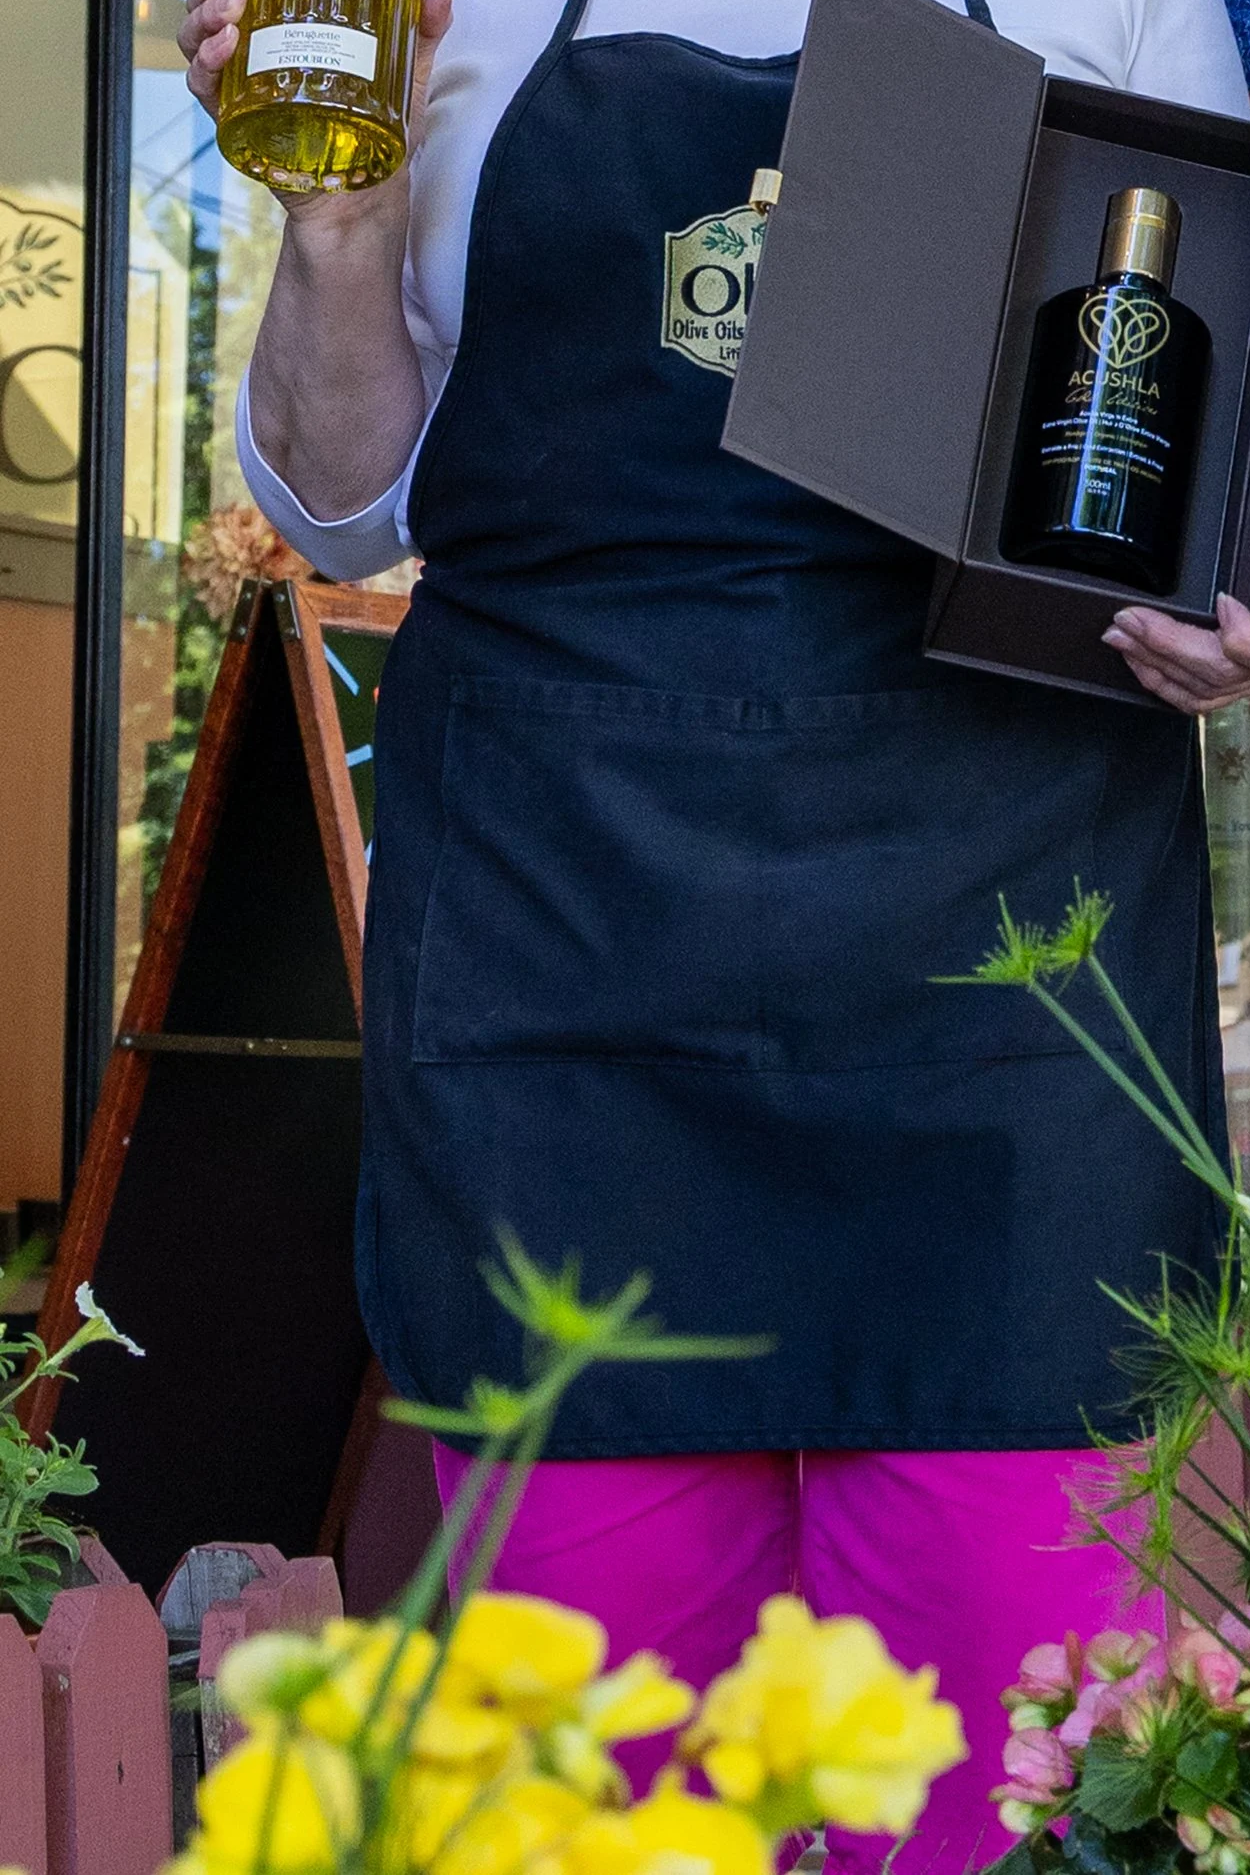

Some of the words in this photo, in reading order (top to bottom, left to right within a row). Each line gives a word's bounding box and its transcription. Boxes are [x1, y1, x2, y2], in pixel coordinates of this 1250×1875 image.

[279, 54, 341, 66] ESTOUBLON
[681, 262, 755, 318] Ol
[673, 319, 709, 339] Olive
[1068, 370, 1160, 399] ACUSHLA
